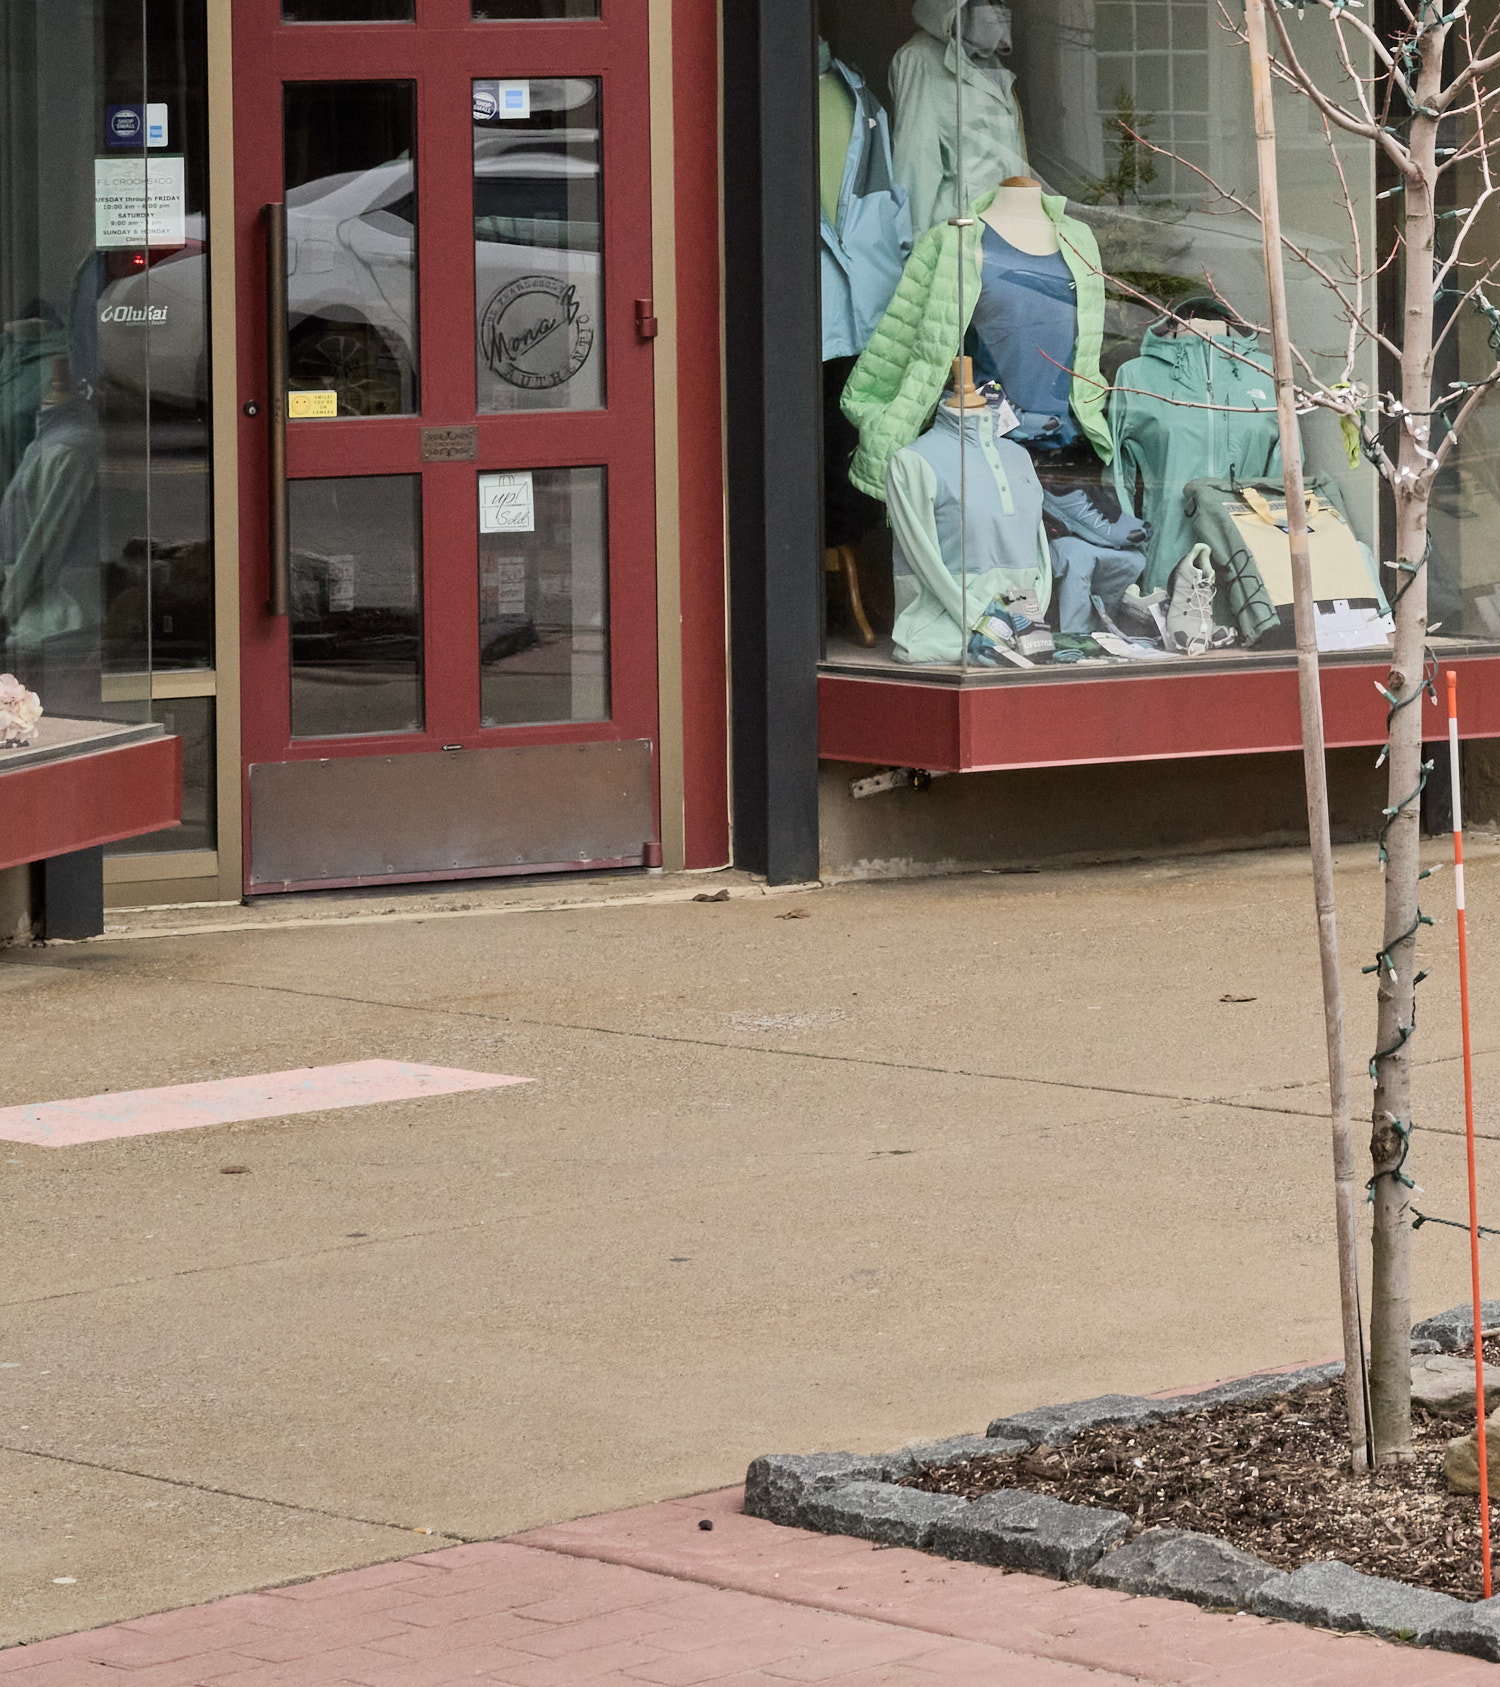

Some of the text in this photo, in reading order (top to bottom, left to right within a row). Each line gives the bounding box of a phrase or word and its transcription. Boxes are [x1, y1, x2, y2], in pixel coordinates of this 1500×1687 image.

[489, 283, 580, 371] Mona B
[1023, 639, 1053, 649] LIFESTYLE
